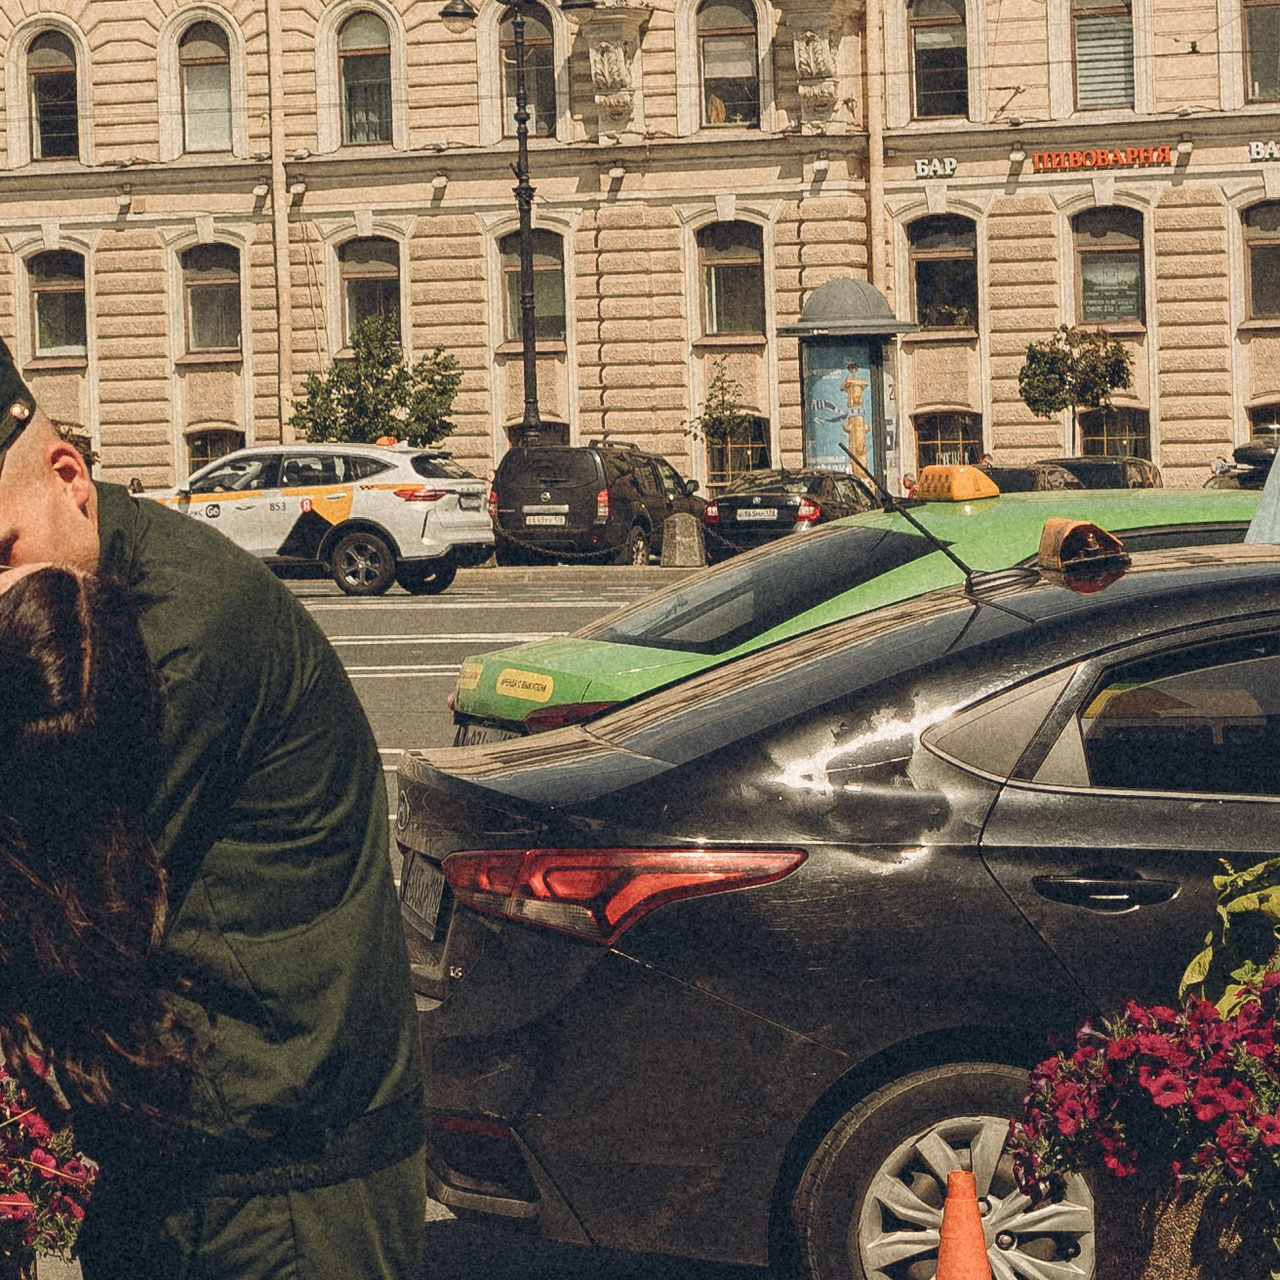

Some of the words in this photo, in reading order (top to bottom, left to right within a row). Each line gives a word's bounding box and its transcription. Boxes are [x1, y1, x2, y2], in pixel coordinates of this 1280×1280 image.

[915, 158, 958, 177] БАР
[1033, 146, 1172, 172] ПИВОВАРНЯ
[269, 502, 286, 511] 853
